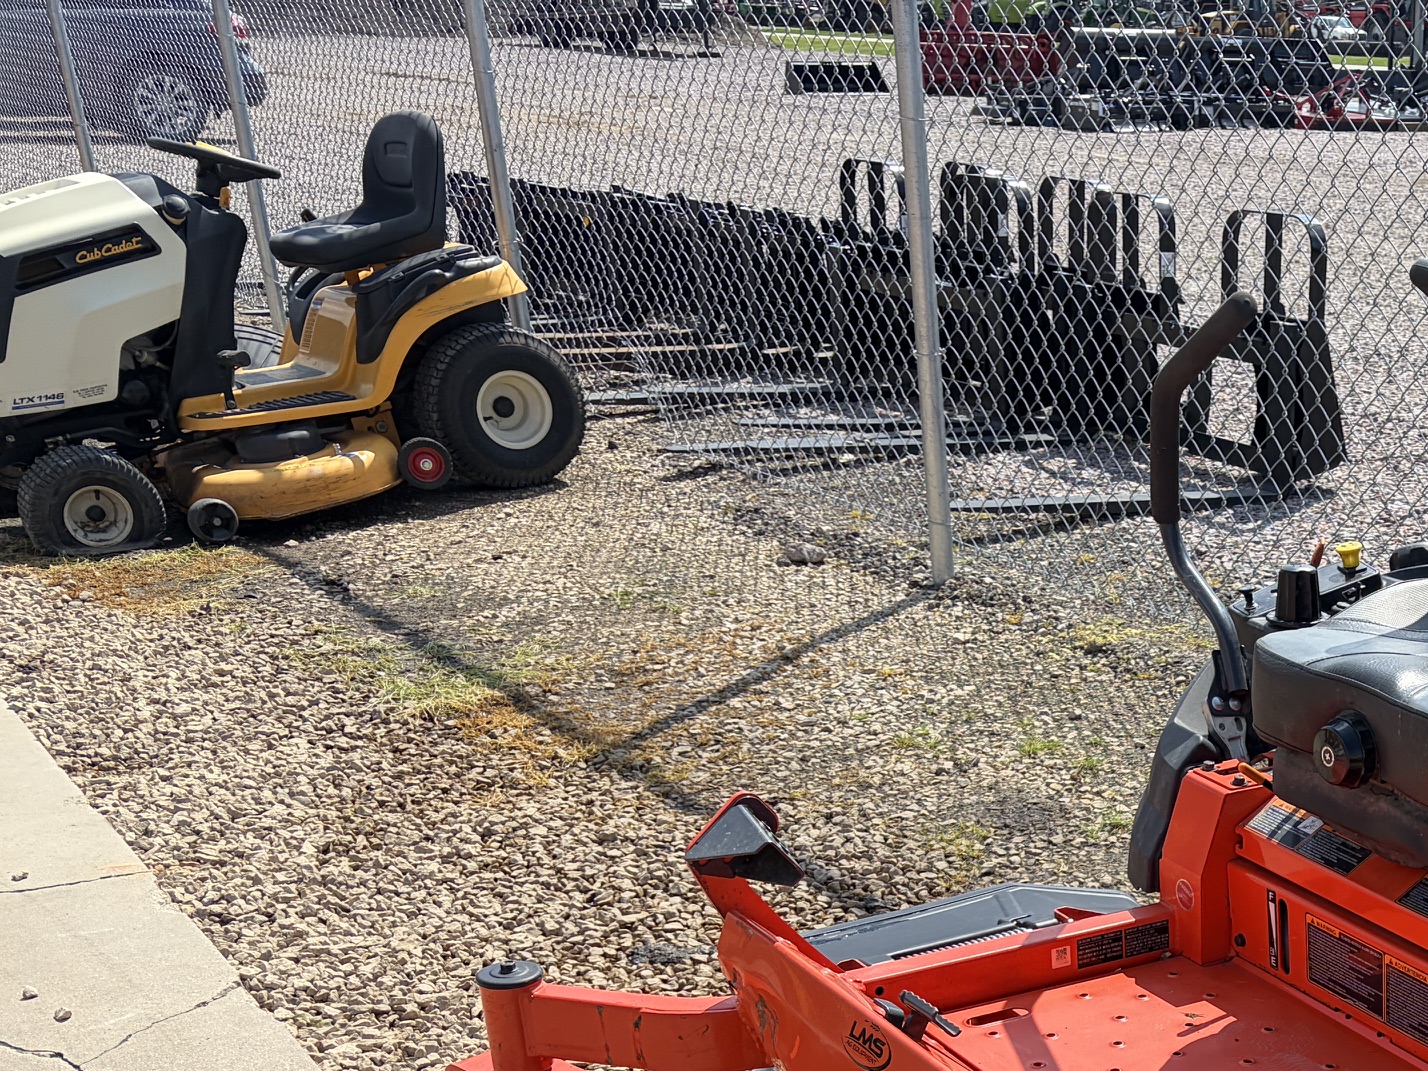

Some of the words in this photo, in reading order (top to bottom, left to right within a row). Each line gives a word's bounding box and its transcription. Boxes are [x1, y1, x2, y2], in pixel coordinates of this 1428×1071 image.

[75, 247, 102, 264] Cub
[101, 236, 143, 257] Cadet
[13, 395, 36, 406] LTX
[36, 392, 65, 404] 1146
[1268, 891, 1275, 901] F
[849, 1020, 887, 1059] LMS
